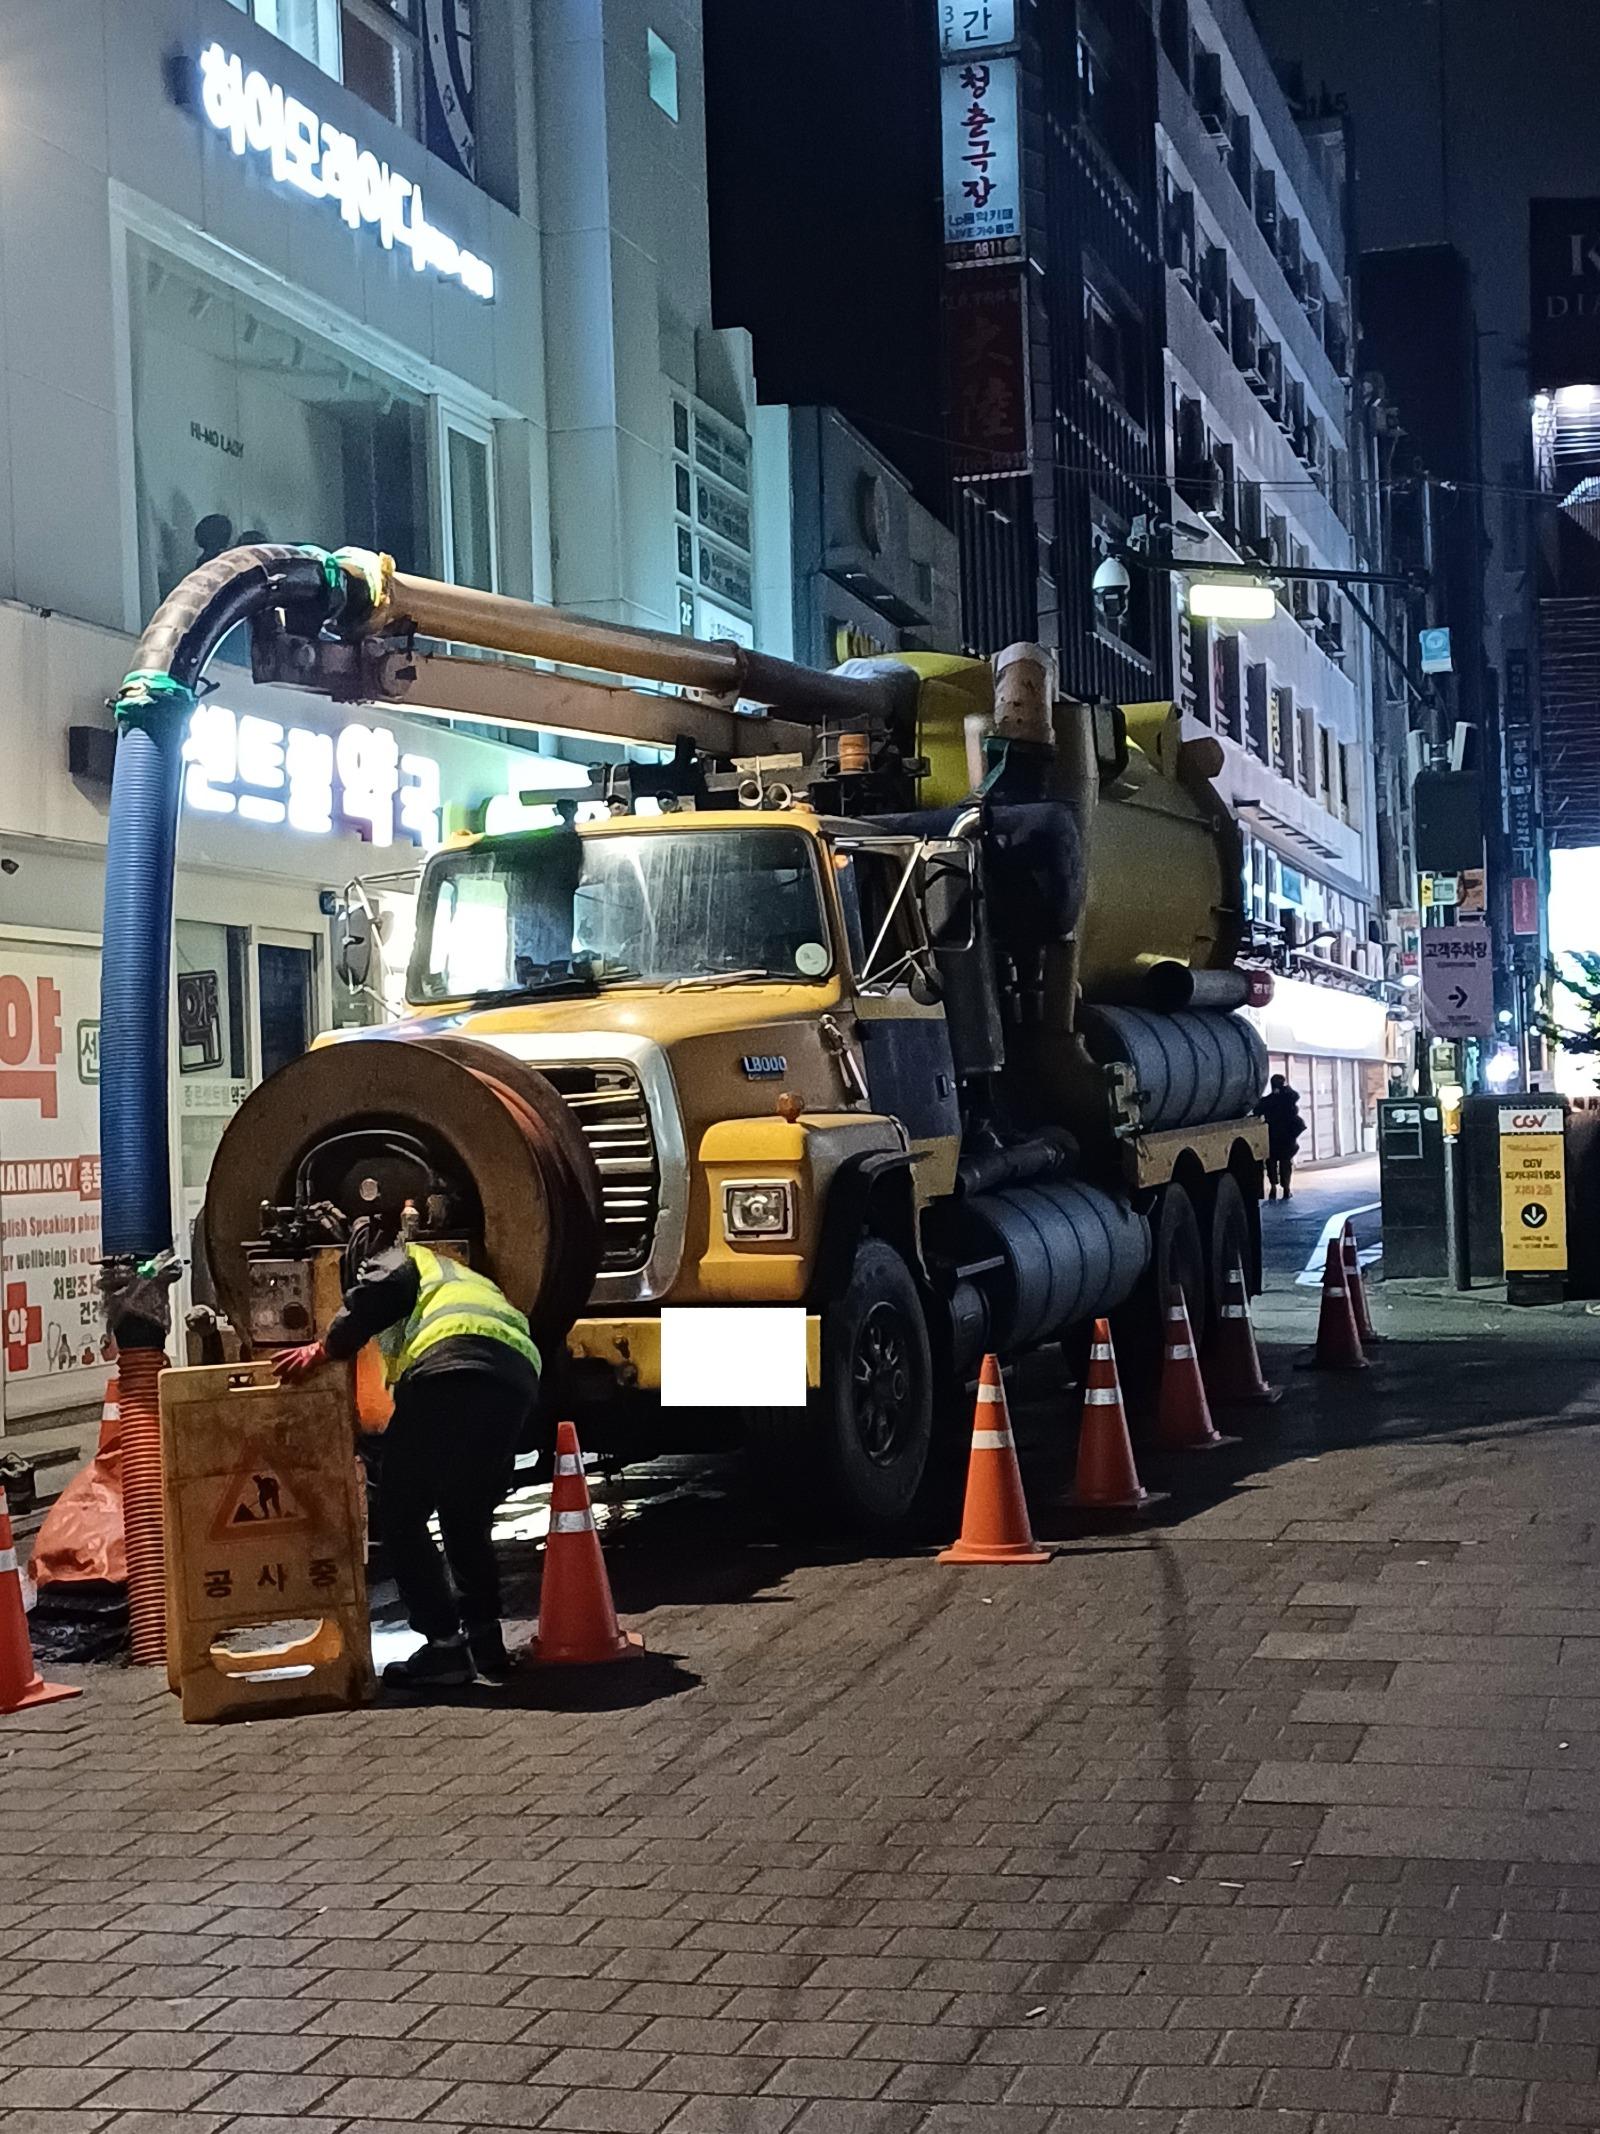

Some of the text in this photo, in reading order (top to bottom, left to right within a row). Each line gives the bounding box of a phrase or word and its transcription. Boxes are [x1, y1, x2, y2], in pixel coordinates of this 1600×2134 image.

[182, 703, 440, 852] 센트럴약국
[1425, 941, 1487, 959] 고객주차장
[1512, 1114, 1547, 1128] CGV
[1523, 1158, 1543, 1168] CGV
[8, 1309, 28, 1347] 약
